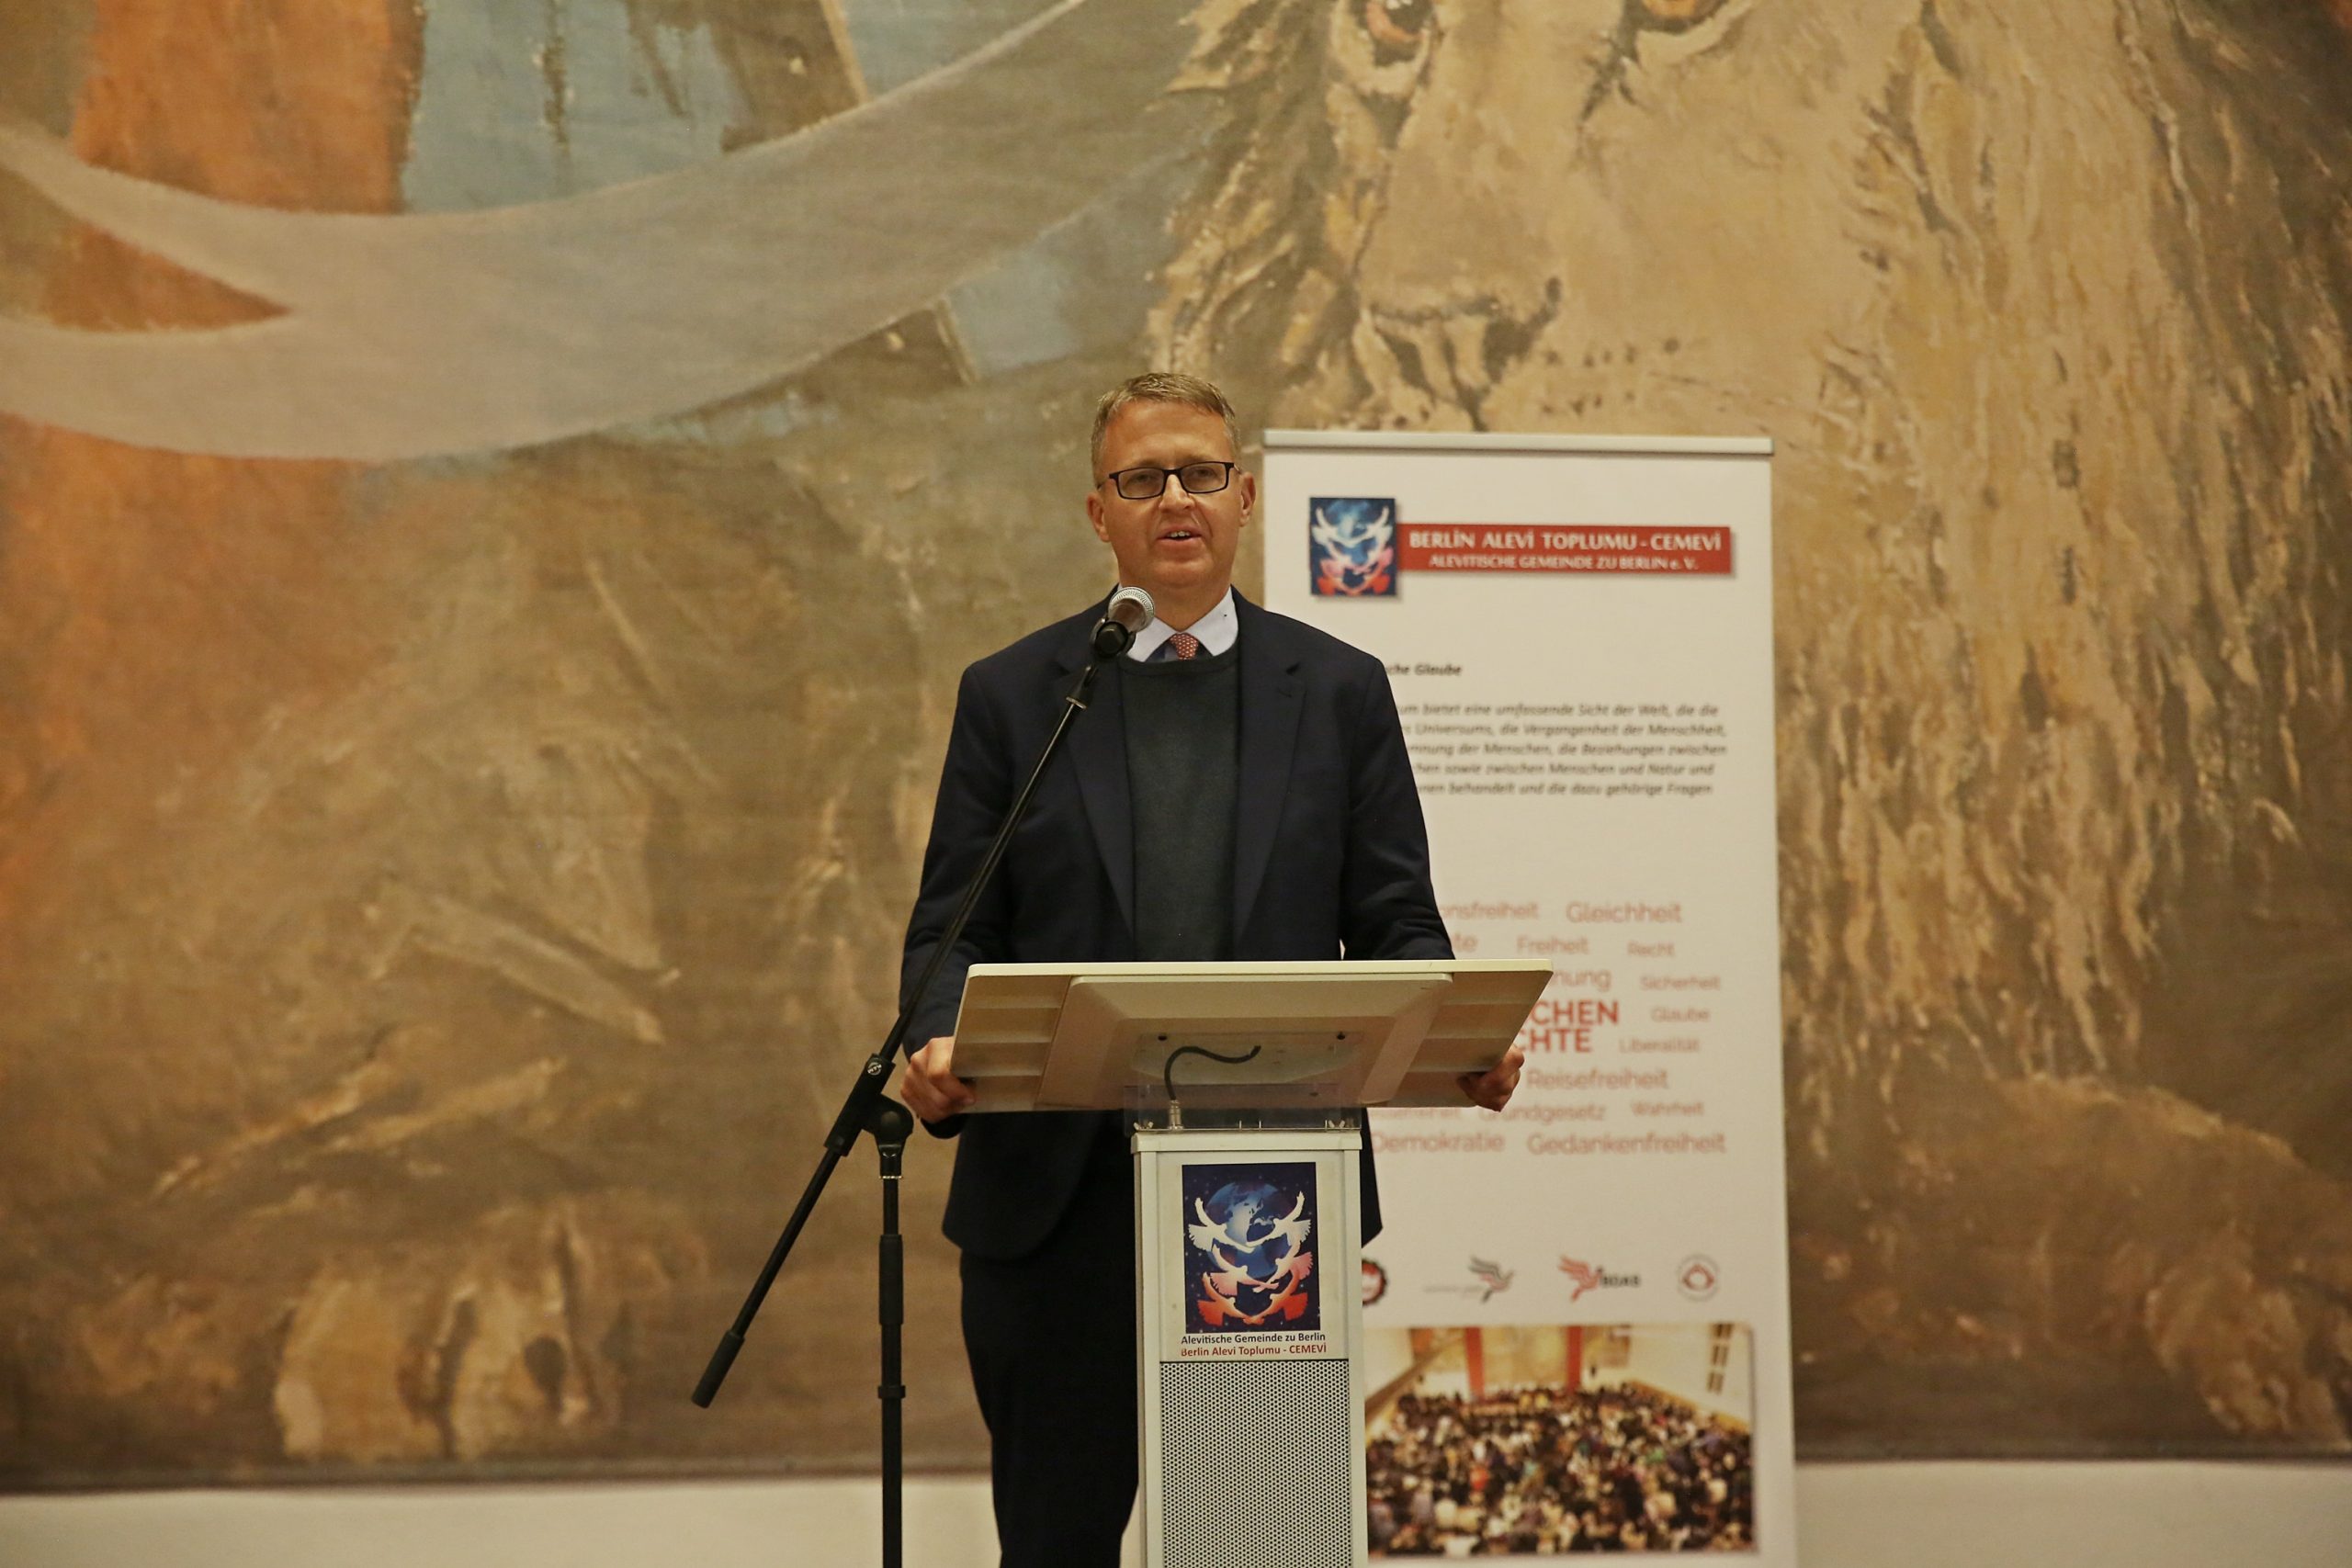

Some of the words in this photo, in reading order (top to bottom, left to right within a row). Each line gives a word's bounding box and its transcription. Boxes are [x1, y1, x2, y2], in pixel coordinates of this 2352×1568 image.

[1409, 528, 1476, 548] BERLİN
[1482, 528, 1534, 549] ALEVİ
[1543, 531, 1637, 550] TOPLUMU
[1650, 531, 1722, 551] CEMEVİ
[1519, 555, 1593, 569] GEMEINDE
[1597, 556, 1617, 570] ZU
[1620, 556, 1668, 570] BERLIN
[1385, 663, 1409, 675] che
[1415, 663, 1462, 675] Glaube
[1464, 705, 1491, 715] eine
[1496, 703, 1574, 717] umfassende
[1613, 705, 1634, 716] der
[1675, 705, 1694, 716] die
[1700, 705, 1719, 716] die
[1499, 724, 1519, 735] die
[1524, 724, 1619, 738] Vergangenheit
[1623, 725, 1644, 736] der
[1459, 744, 1479, 755] der
[1557, 743, 1577, 755] die
[1581, 743, 1664, 758] Beziehungen
[1668, 744, 1727, 756] zwischen
[1486, 763, 1544, 774] zwischen
[1549, 763, 1614, 775] Menschen
[1619, 763, 1645, 775] und
[1689, 763, 1715, 775] und
[1449, 783, 1514, 795] behandelt
[1519, 783, 1544, 795] und
[1547, 783, 1566, 795] die
[1667, 783, 1713, 798] Fragen
[1439, 901, 1539, 919] onsfreiheit
[1566, 901, 1683, 924] Gleichheit
[1453, 933, 1478, 953] te
[1516, 935, 1589, 956] Freiheit
[1627, 941, 1675, 957] Recht
[1550, 970, 1611, 992] nung
[1639, 975, 1721, 991] Sicherheit
[1531, 999, 1619, 1026] CHEN
[1650, 1006, 1711, 1023] Glaube
[1516, 1028, 1593, 1054] CHTE
[1618, 1037, 1701, 1054] Liberalität
[1526, 1068, 1668, 1089] Reisefreiheit
[1630, 1101, 1705, 1116] Wahrheit
[1371, 1130, 1505, 1153] Demokratie
[1526, 1131, 1727, 1155] Gedankenfreiheit
[1181, 1333, 1232, 1345] Alevitische
[1234, 1333, 1283, 1344] Gemeinde
[1285, 1334, 1296, 1342] zu
[1298, 1332, 1326, 1342] Berlin
[1181, 1347, 1209, 1357] Berlin
[1212, 1346, 1236, 1356] Alevi
[1238, 1346, 1281, 1357] Toplumu
[1289, 1342, 1327, 1354] CEMEVİ
